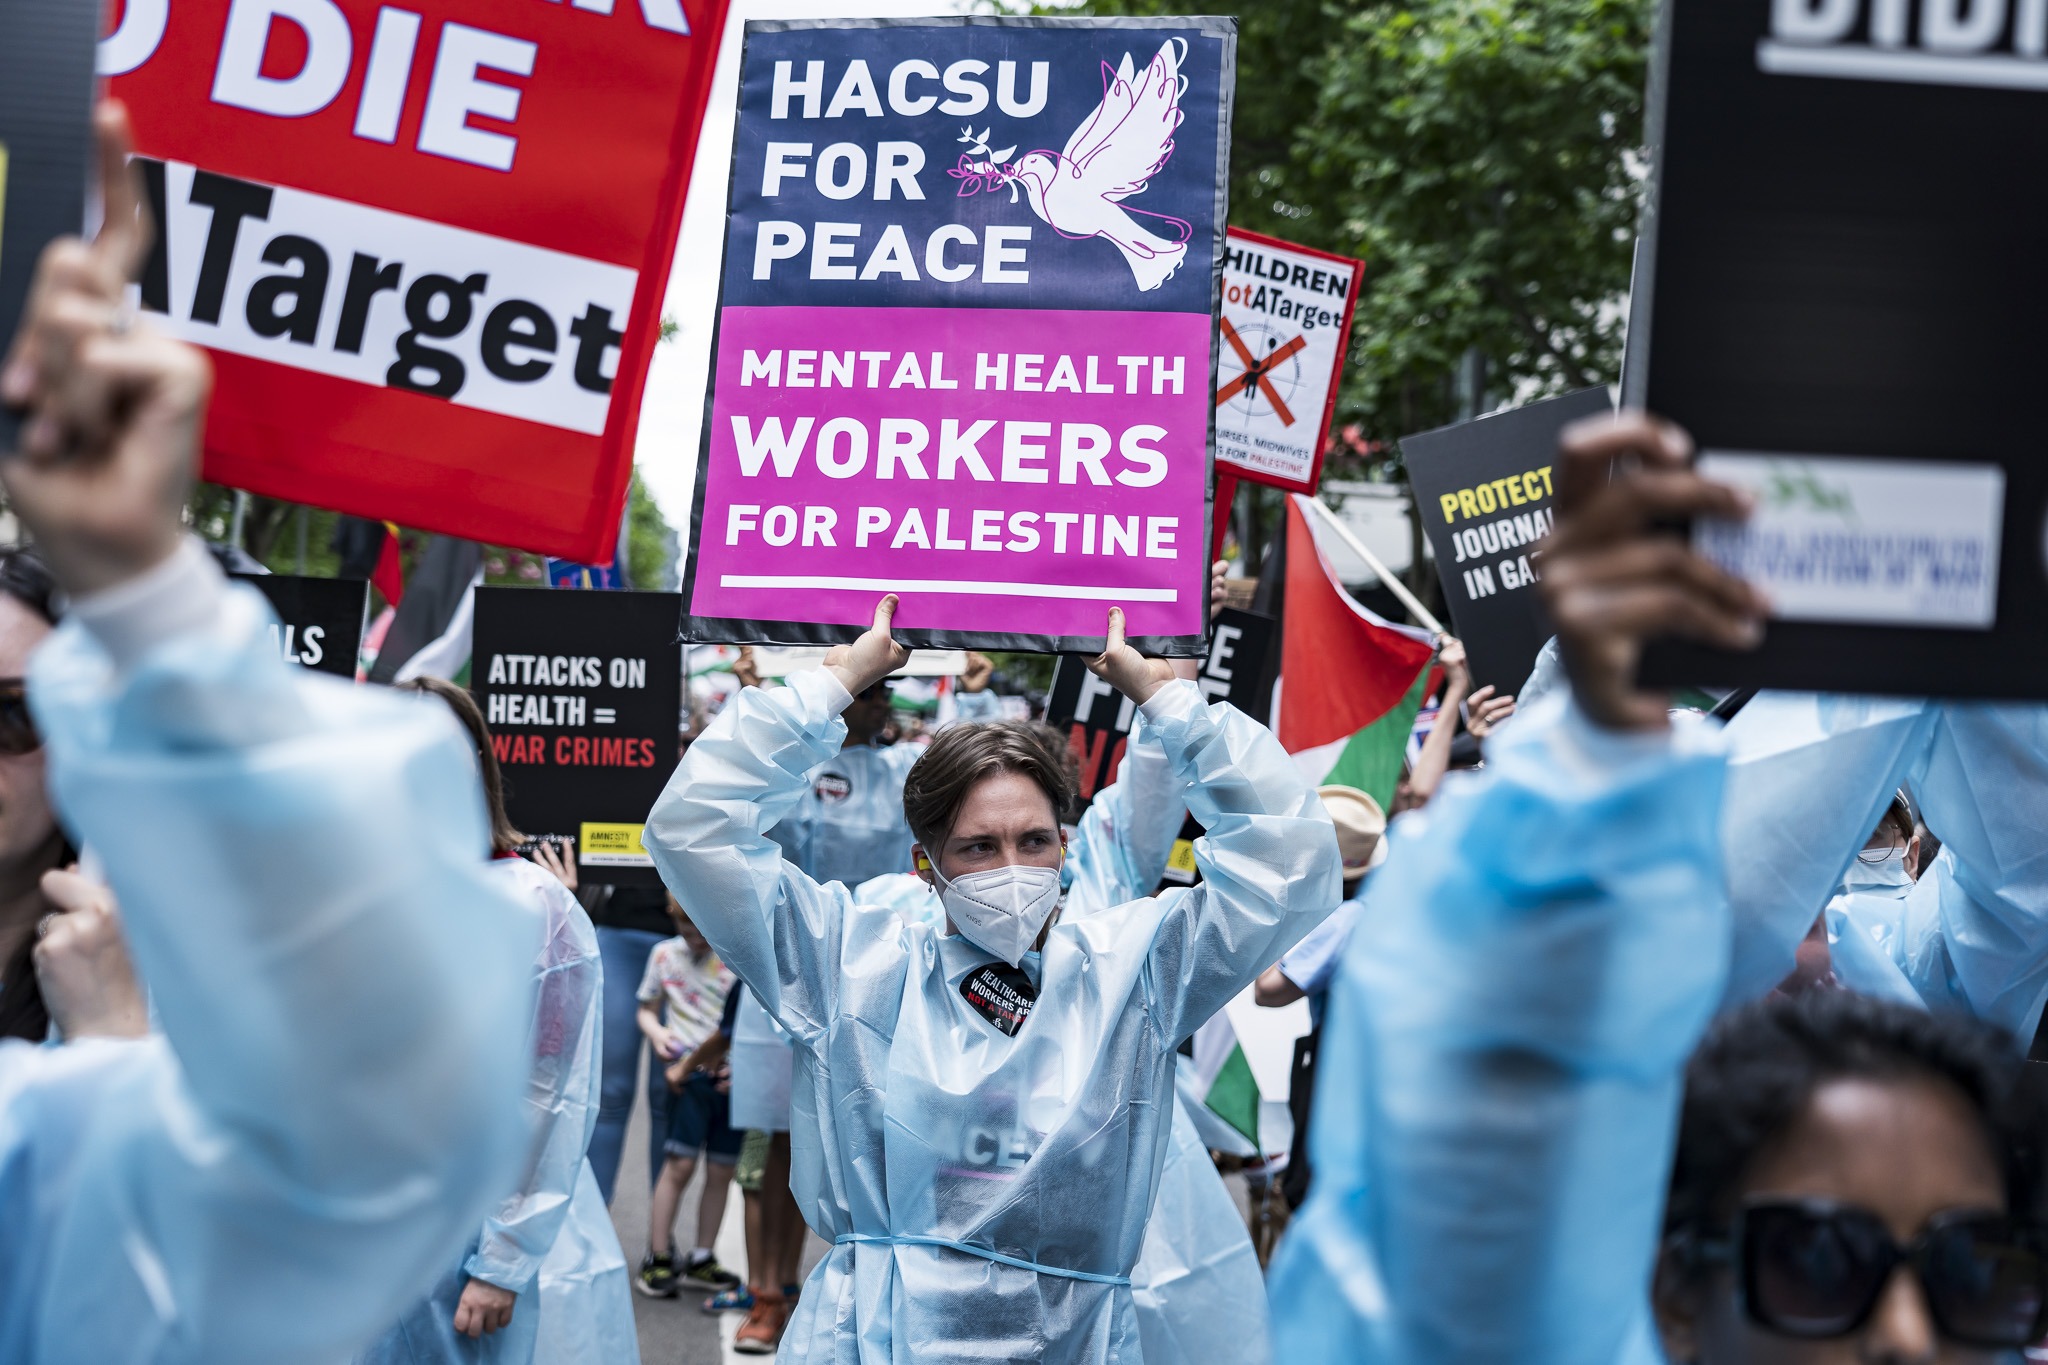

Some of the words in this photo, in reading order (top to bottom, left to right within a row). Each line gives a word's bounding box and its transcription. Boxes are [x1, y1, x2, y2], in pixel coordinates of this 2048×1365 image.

[209, 0, 539, 173] DIE
[770, 58, 1051, 120] HACSU
[761, 140, 927, 201] FOR
[752, 220, 1033, 285] PEACE
[1223, 246, 1349, 299] HILDREN
[740, 349, 958, 390] MENTAL
[974, 353, 1186, 395] HEALTH
[730, 415, 1169, 488] WORKERS
[1439, 465, 1554, 524] PROTECT
[726, 504, 838, 548] FOR
[855, 506, 1180, 560] PALESTINE
[1463, 565, 1497, 600] IN
[487, 653, 603, 688] ATTACKS
[609, 657, 647, 689] ON
[488, 693, 587, 727] HEALTH
[488, 734, 546, 765] WAR
[554, 735, 656, 768] CRIMES
[965, 912, 983, 927] KN95
[967, 991, 987, 1007] NOT
[988, 1003, 995, 1012] A
[970, 978, 1015, 1011] WORKERS
[981, 969, 1035, 1008] HEALTHCARE
